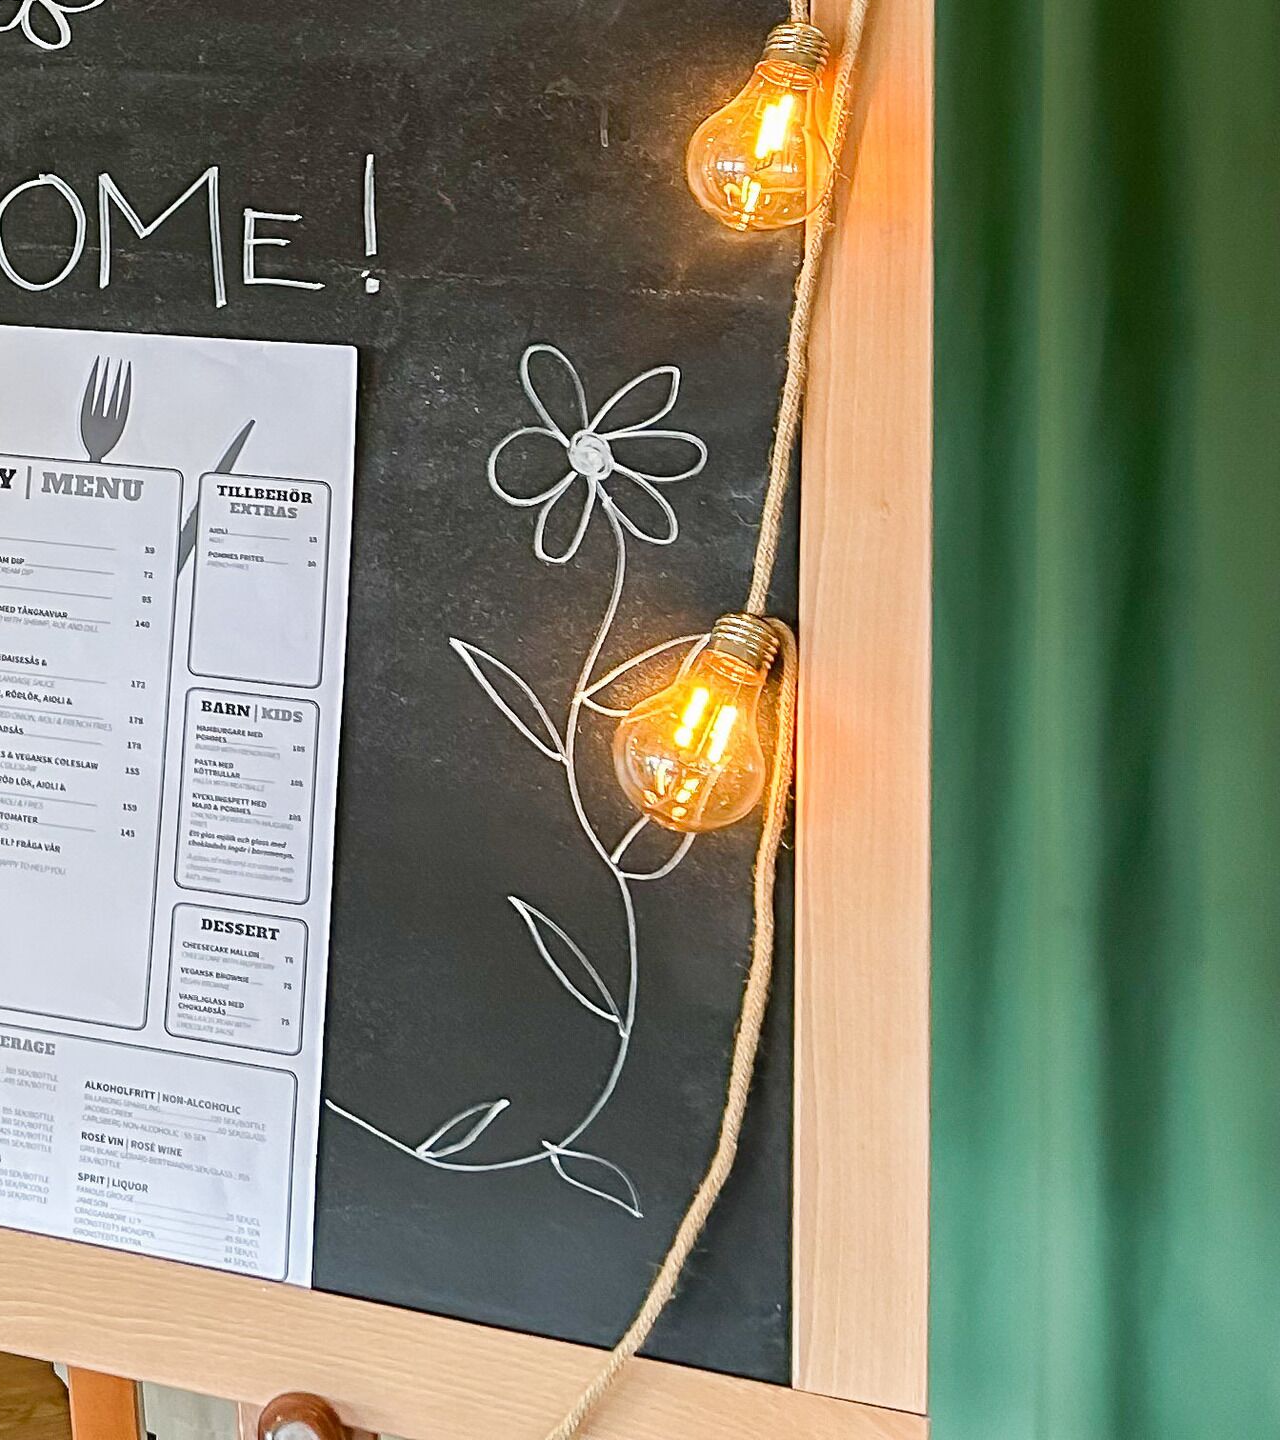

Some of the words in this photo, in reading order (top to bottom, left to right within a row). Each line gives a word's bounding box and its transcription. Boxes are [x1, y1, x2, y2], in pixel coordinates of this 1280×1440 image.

[40, 471, 145, 502] MENU
[216, 484, 313, 505] TILLBEHÖR
[229, 501, 299, 519] EXTRAS
[200, 700, 251, 718] BARN
[260, 706, 304, 724] KIDS
[54, 756, 99, 770] COLESLAW
[200, 918, 280, 941] DESSERT
[84, 1080, 156, 1100] ALKOHOLFRITT
[162, 1093, 241, 1116] NON-ALCOHOLIC
[81, 1131, 107, 1144] ROSÉ
[130, 1139, 156, 1153] ROSÉ
[157, 1144, 183, 1158] WINE
[77, 1172, 106, 1185] SPRIT
[111, 1178, 149, 1194] LIQUOR
